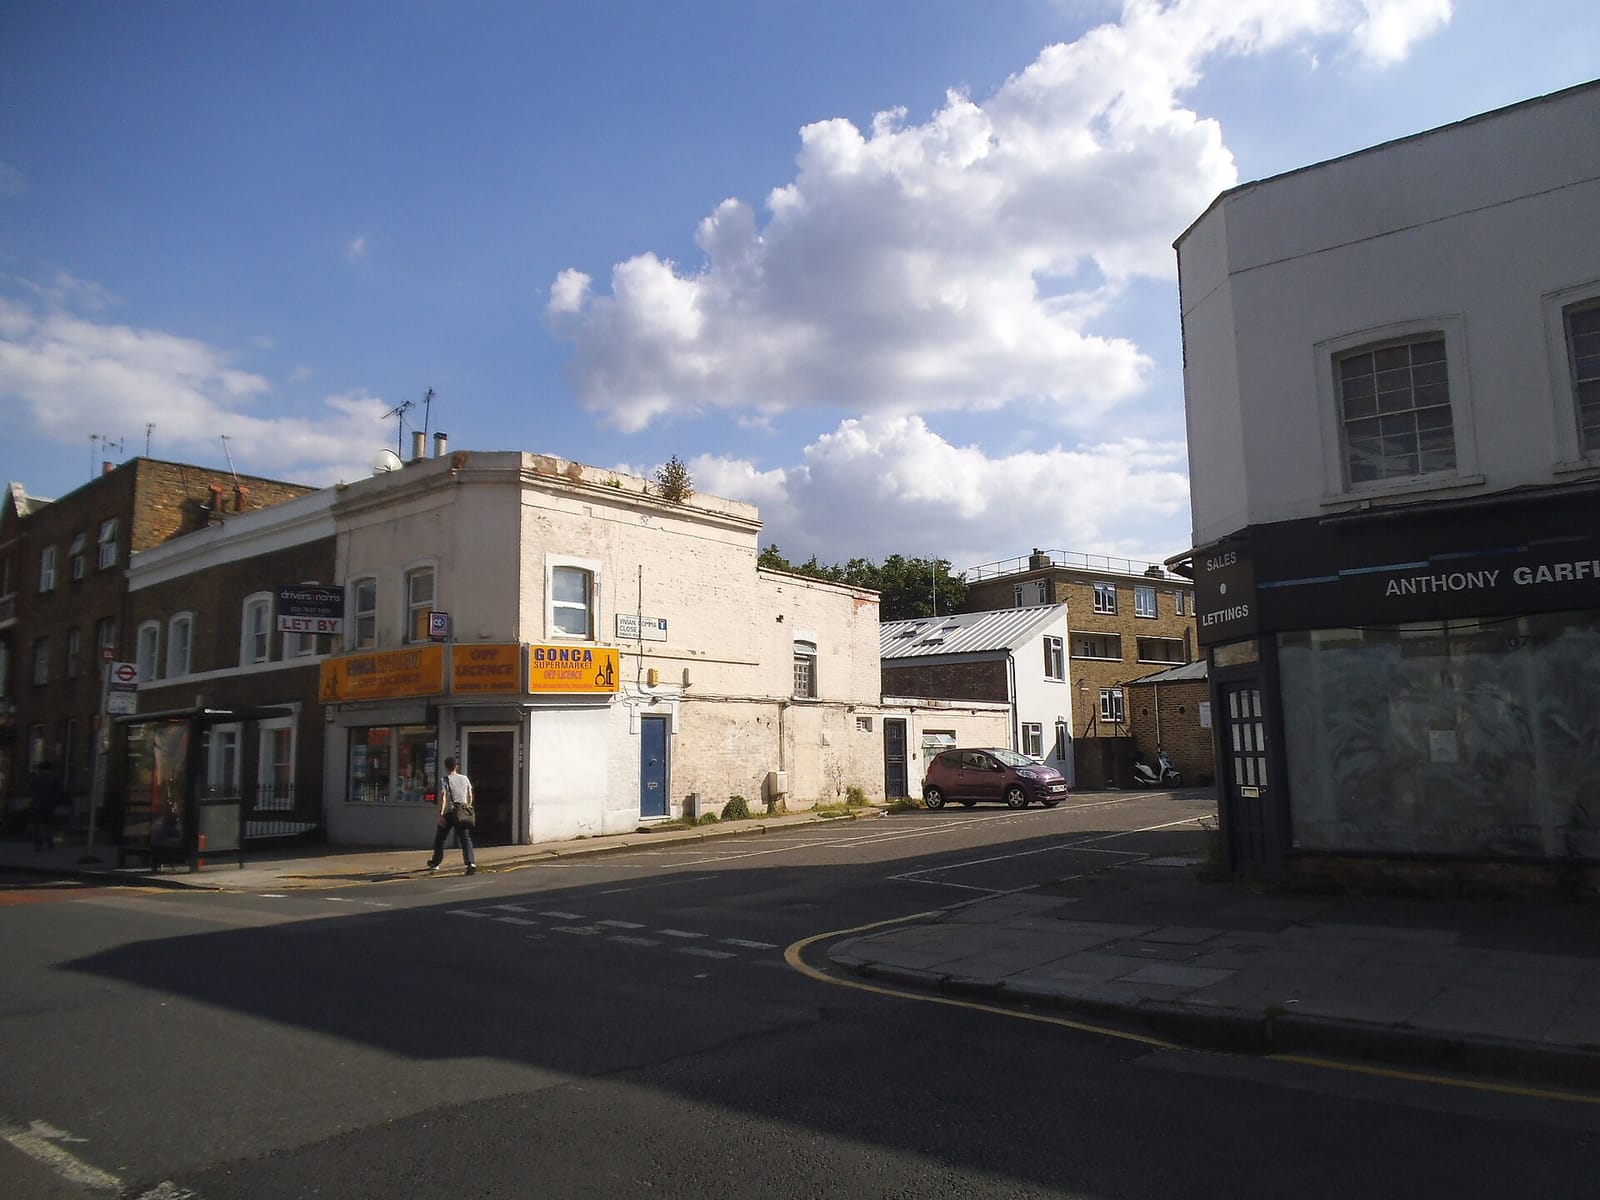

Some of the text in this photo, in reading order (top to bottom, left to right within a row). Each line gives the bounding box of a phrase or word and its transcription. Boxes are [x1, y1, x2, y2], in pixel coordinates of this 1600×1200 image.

[1206, 551, 1237, 572] SALES
[1385, 569, 1500, 596] ANTHONY
[1202, 604, 1249, 627] LETTINGS
[282, 618, 338, 631] LET BY
[619, 625, 638, 633] CLOSE
[534, 648, 593, 661] GONCA
[534, 660, 593, 669] SUPERMARKET
